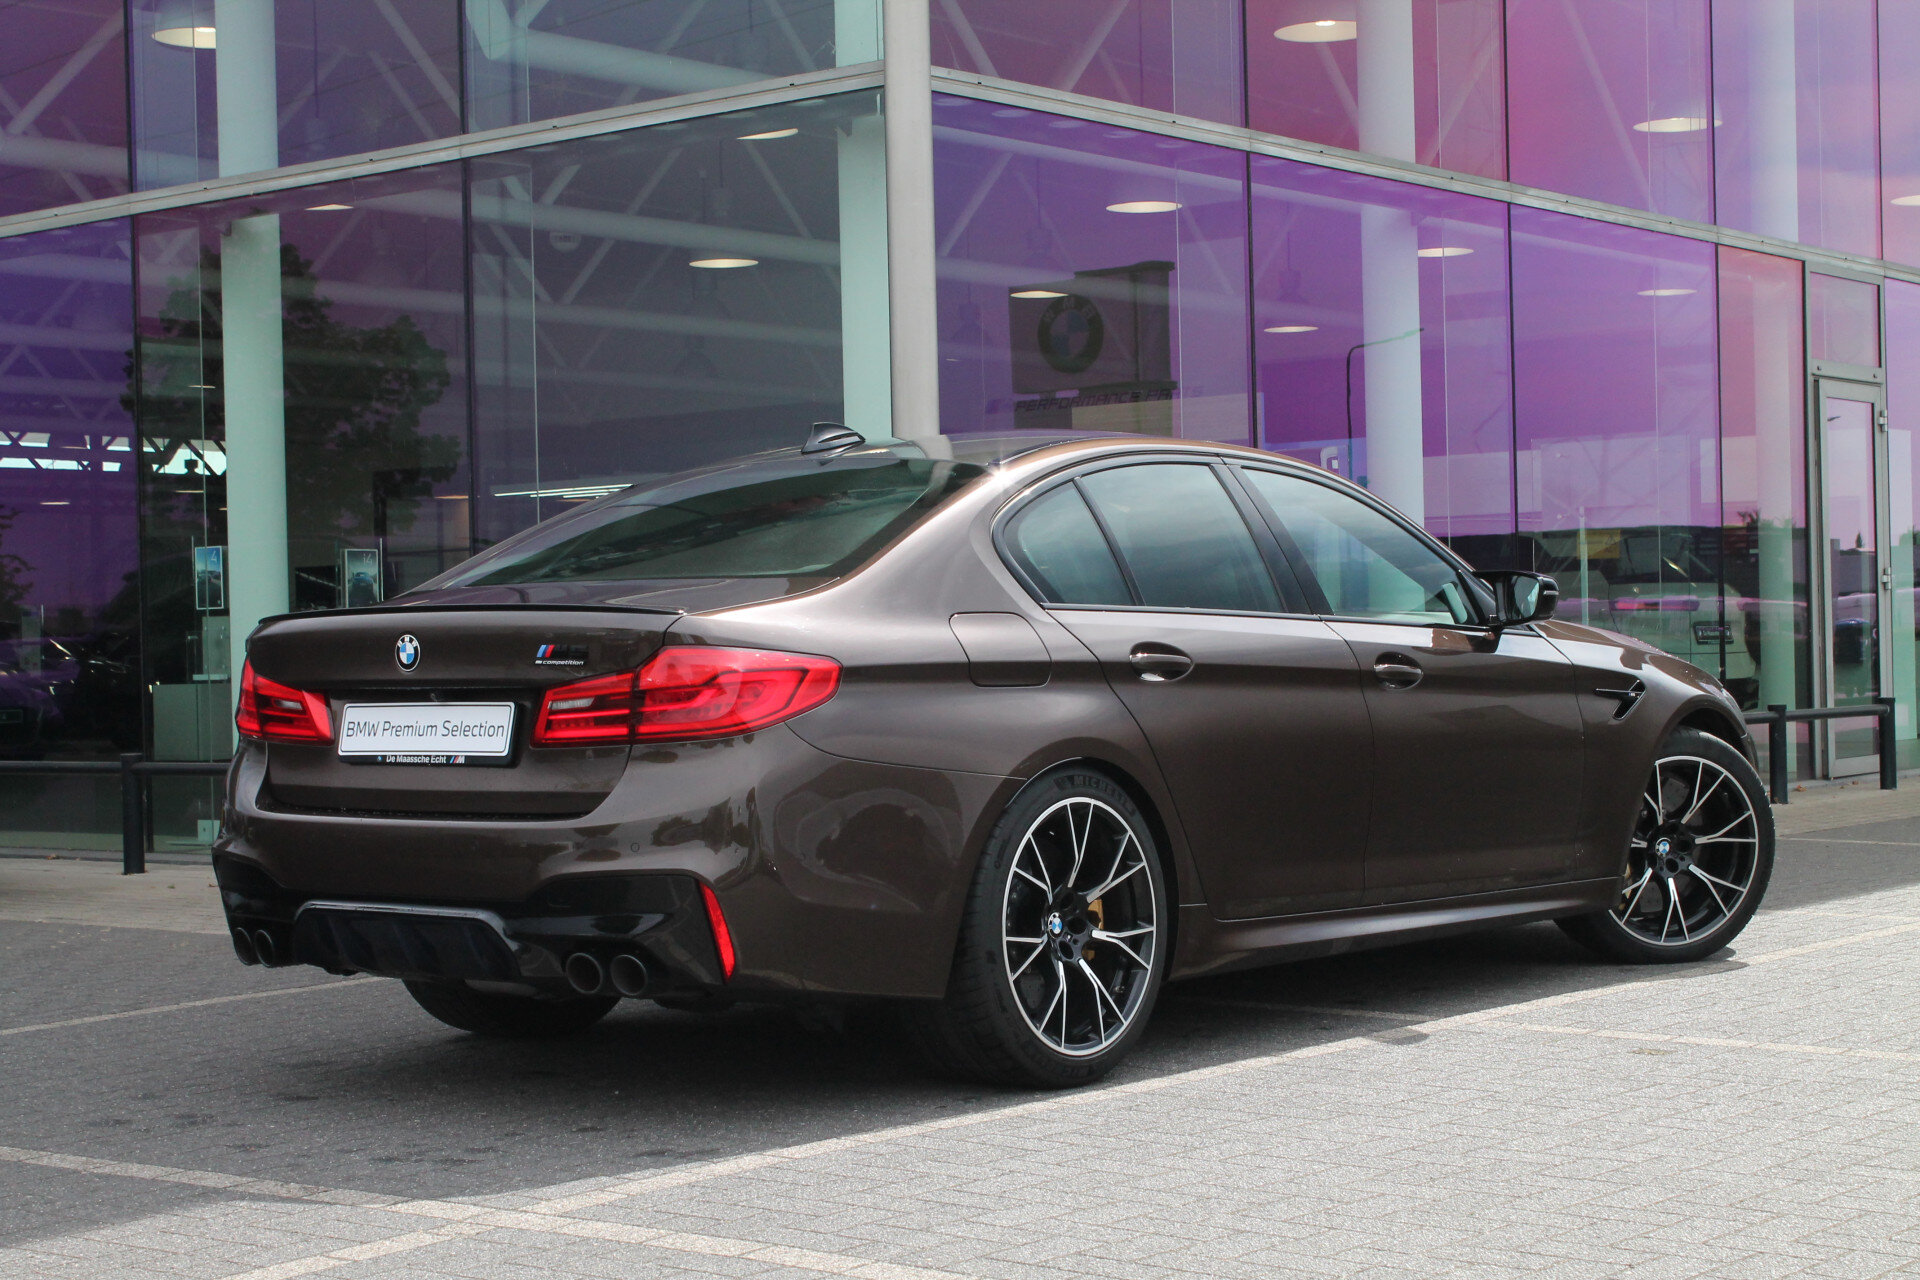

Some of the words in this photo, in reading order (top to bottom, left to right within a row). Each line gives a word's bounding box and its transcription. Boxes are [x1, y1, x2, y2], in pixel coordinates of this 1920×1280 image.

[1013, 390, 1141, 413] PERFORMANCE
[210, 550, 218, 563] 4
[363, 552, 373, 567] i4
[346, 721, 380, 737] BMW
[382, 720, 438, 737] Premium
[441, 719, 505, 738] Selection
[386, 755, 395, 763] De
[396, 755, 429, 764] Maassche
[430, 755, 447, 764] Echt
